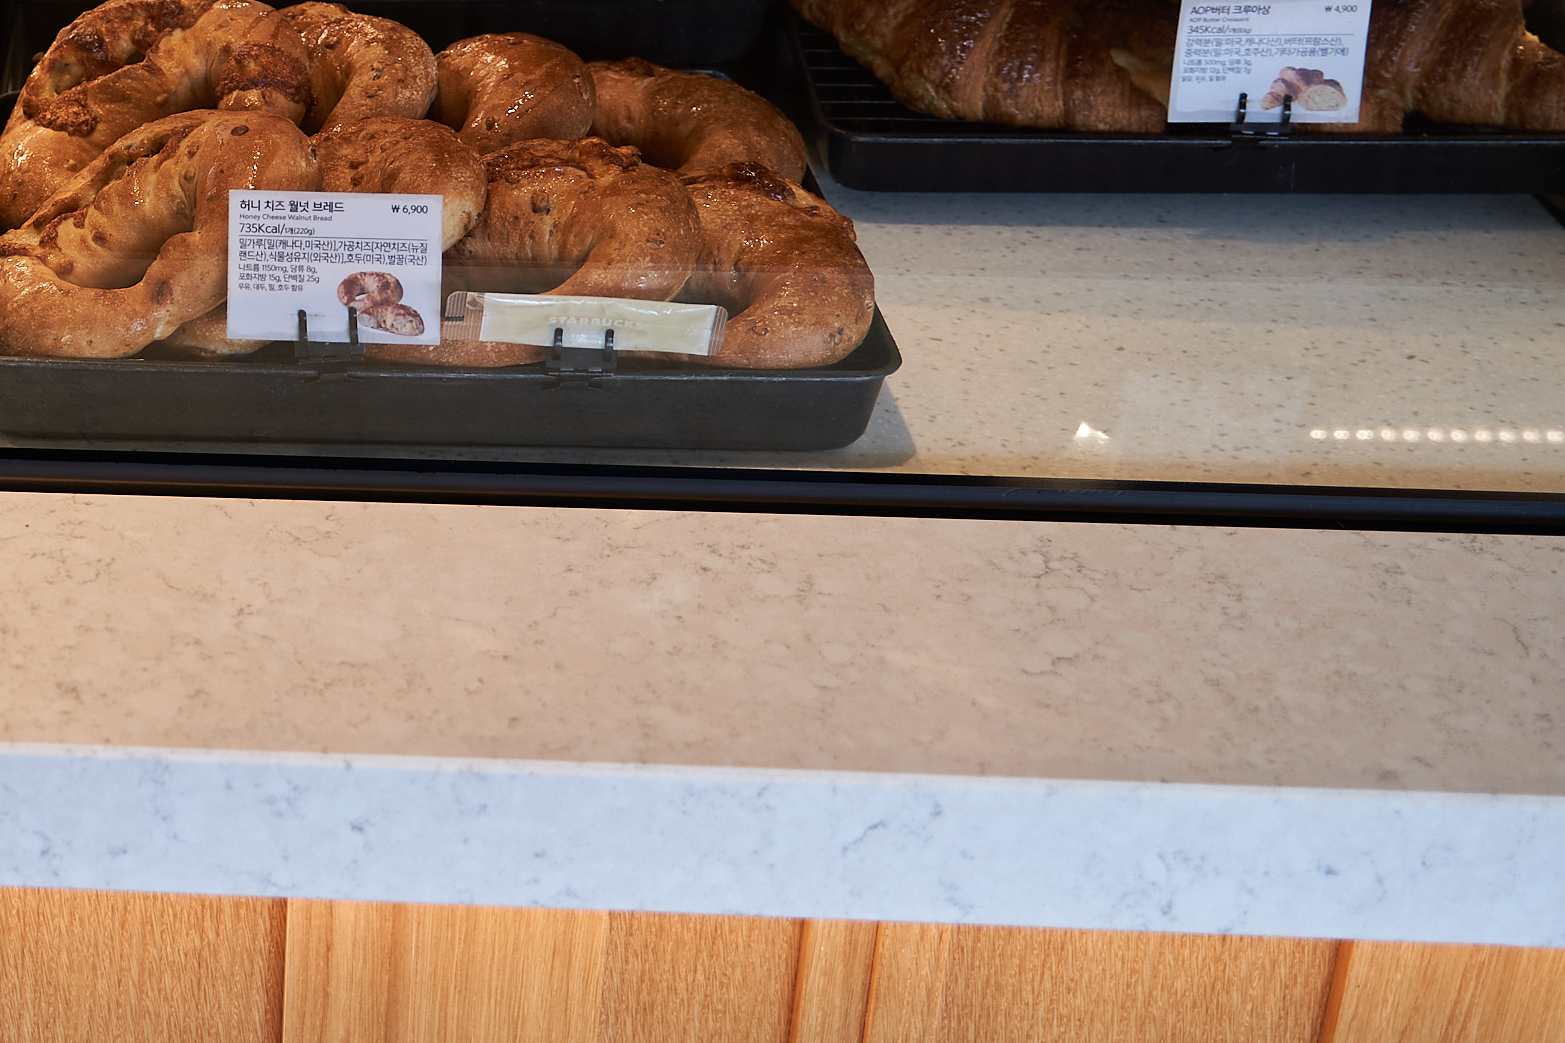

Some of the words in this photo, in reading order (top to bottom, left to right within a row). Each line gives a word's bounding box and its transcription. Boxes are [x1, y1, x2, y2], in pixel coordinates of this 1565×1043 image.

[1190, 6, 1230, 15] AOP버터
[1232, 5, 1271, 14] 크루아상
[1334, 5, 1357, 13] 4,900
[240, 200, 261, 211] 허니
[264, 200, 285, 211] 치즈
[288, 201, 309, 213] 월넛
[313, 201, 344, 213] 브레드
[403, 205, 428, 214] 6,900
[239, 264, 259, 272] 나트륨
[262, 265, 288, 273] 1150mg,
[291, 265, 304, 273] 당류
[239, 274, 266, 282] 포화지방
[269, 274, 281, 282] 15g,
[284, 275, 305, 283] 단백질
[547, 316, 643, 329] STARBUCKS
